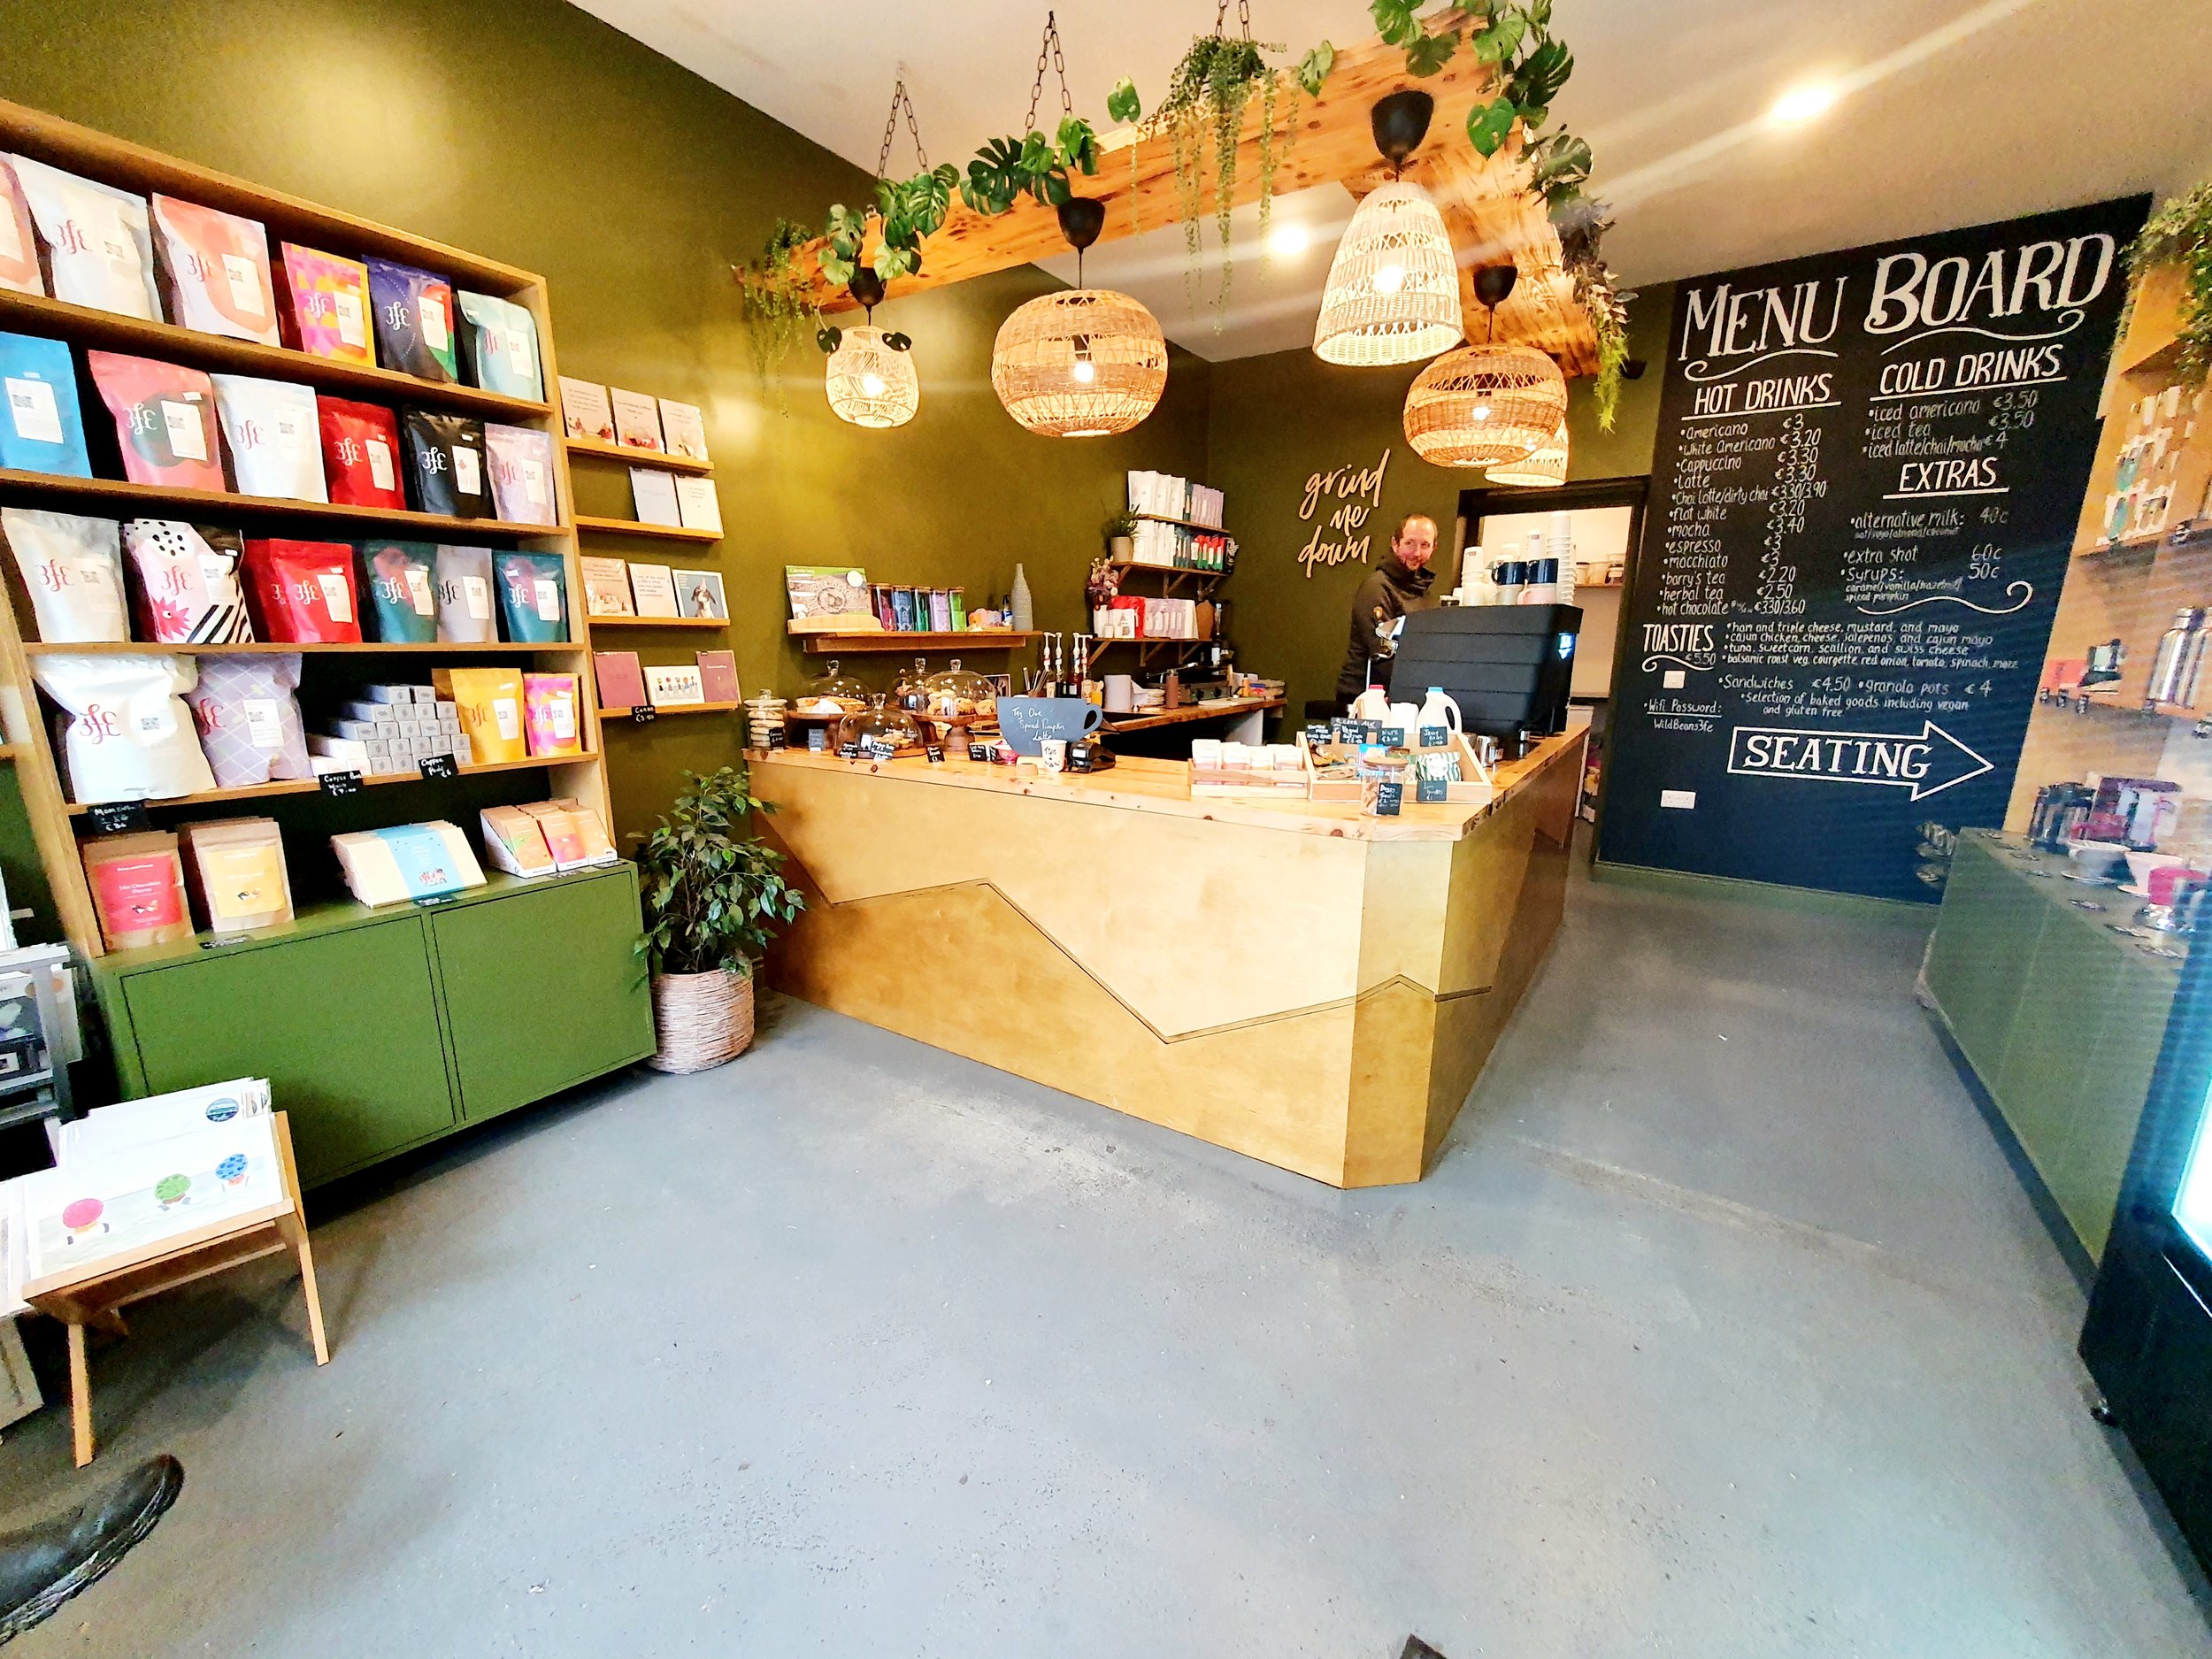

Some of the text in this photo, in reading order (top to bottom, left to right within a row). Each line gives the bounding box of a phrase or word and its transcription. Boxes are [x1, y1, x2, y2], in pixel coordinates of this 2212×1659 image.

[1863, 233, 2116, 334] BOARD
[1879, 344, 2064, 396] COLD DRINKS
[1694, 373, 1832, 416] HOT DRINKS
[1874, 389, 2039, 422] iced americano €3.50
[1870, 410, 2035, 440] iced tea €3.50
[1779, 427, 1822, 449] €3.20
[1680, 446, 1819, 476] Cappuccino €3.30
[1867, 441, 1892, 460] iced
[1299, 449, 1391, 520] grind
[1774, 464, 1816, 484] €3.30
[1898, 457, 1999, 493] EXTRAS
[1748, 484, 1770, 503] chai
[1329, 504, 1371, 537] me
[1673, 507, 1694, 522] flat
[1768, 499, 1806, 518] €3.20
[1854, 511, 1925, 530] alternative
[1978, 505, 2010, 525] 40c
[1671, 516, 1806, 537] mocha €3.40
[1297, 524, 1371, 580] down
[1668, 534, 1783, 555] espresso €3
[1847, 542, 2004, 565] extra shot 60c
[1669, 550, 1780, 568] macchiato €3
[1967, 561, 2001, 580] 50c
[1665, 565, 1798, 588] barry's tea €2.20
[1663, 583, 1793, 602] herbal tea €2.50
[1661, 601, 1678, 617] hot
[1679, 600, 1730, 617] chocolate
[1642, 623, 1715, 653] TOASTIES
[1732, 621, 1754, 633] ham
[1755, 621, 1775, 633] and
[1777, 621, 1805, 634] triple
[1901, 621, 1923, 634] and
[1928, 623, 1961, 636] mayo
[1730, 633, 1758, 643] cajun
[1900, 634, 1922, 644] and
[1926, 634, 1958, 646] cajun
[1961, 635, 1994, 648] mayo
[1867, 644, 1889, 654] and
[1894, 645, 1925, 655] swiss
[1928, 645, 1970, 656] cheese
[1860, 654, 1878, 666] red
[1723, 673, 1794, 691] Sandwiches
[1811, 676, 1852, 693] €4.50
[1864, 679, 1915, 695] granola
[1920, 682, 1951, 696] pots
[1763, 703, 1844, 718] and gluten free
[1793, 691, 1808, 705] of
[1809, 692, 1842, 707] baked
[1845, 695, 1879, 710] goods
[1884, 695, 1933, 713] including
[1937, 700, 1970, 713] vegan
[1742, 734, 1933, 780] SEATING
